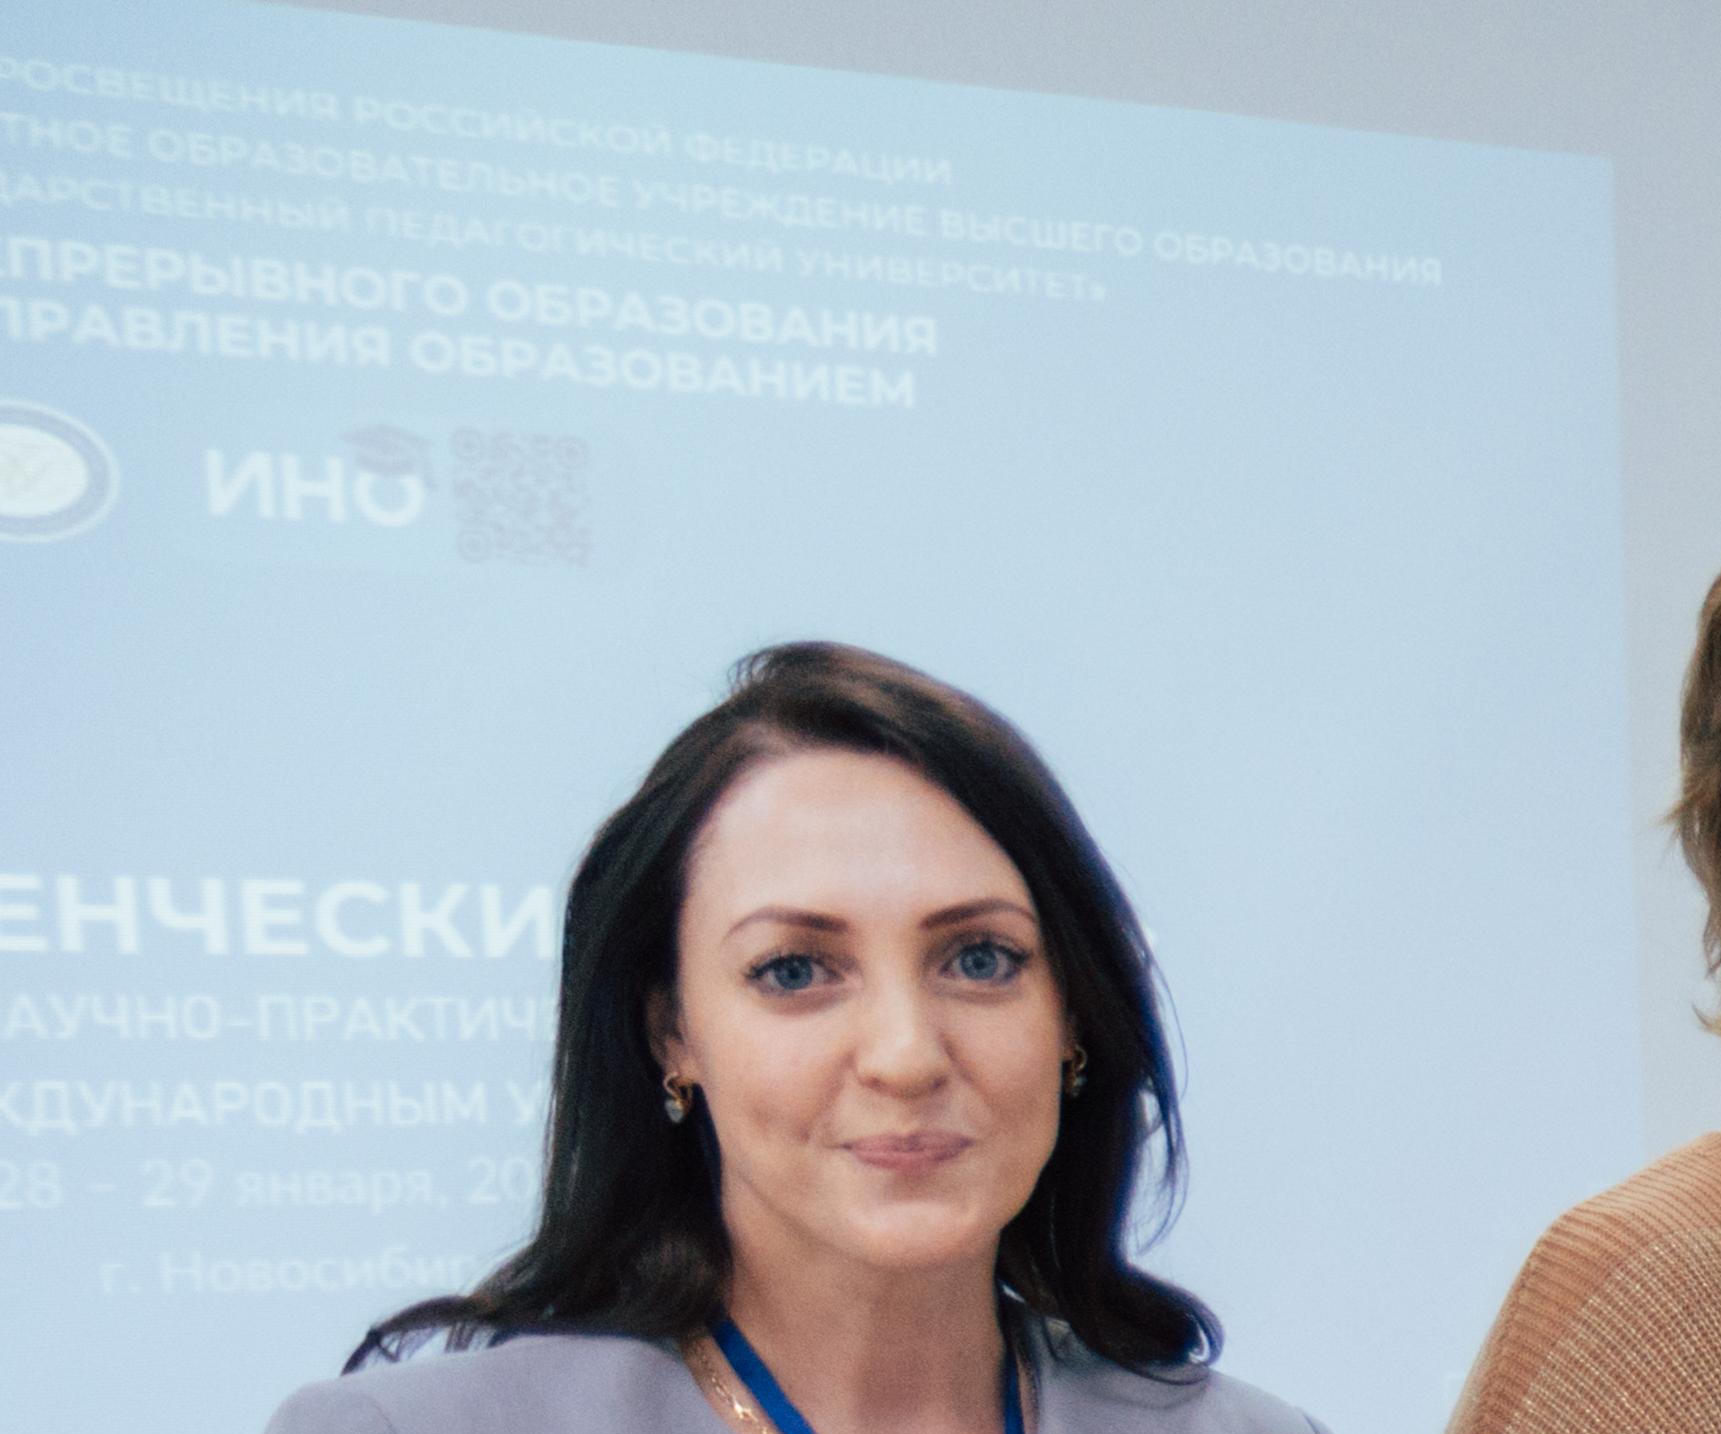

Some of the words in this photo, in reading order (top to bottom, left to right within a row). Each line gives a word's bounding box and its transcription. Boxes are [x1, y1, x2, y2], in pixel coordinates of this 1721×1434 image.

[148, 129, 619, 209] ОБРАЗОВАТЕЛЬНОЕ
[632, 181, 926, 236] УЧРЕЖДЕНИЕ
[940, 207, 1144, 257] ВЫСШЕГО
[1154, 230, 1443, 287] ОБРАЗОВАНИЯ
[0, 236, 468, 318] ПРЕРЫВНОГО
[486, 281, 938, 356] ОБРАЗОВАНИЯ
[411, 331, 916, 408] ОБРАЗОВАНИЕМ
[203, 447, 430, 527] ИНО
